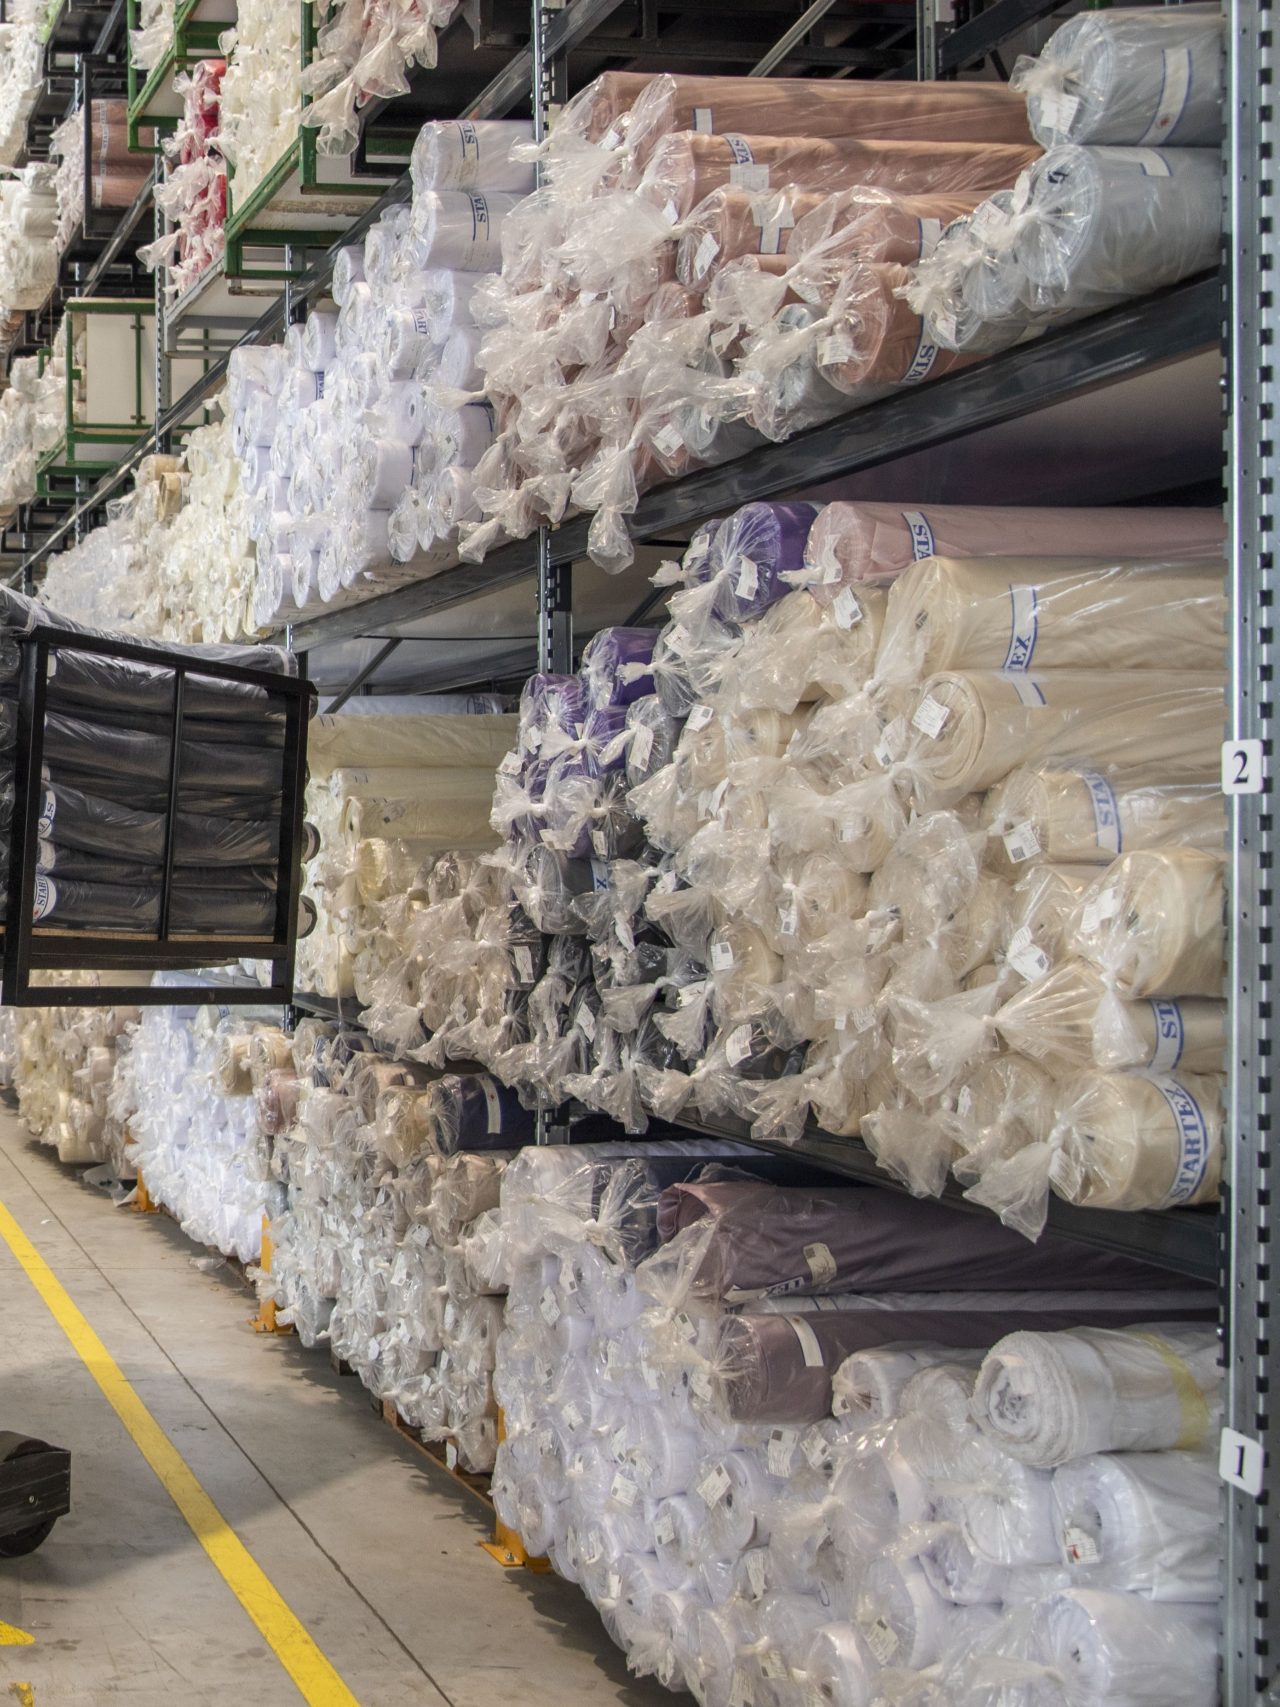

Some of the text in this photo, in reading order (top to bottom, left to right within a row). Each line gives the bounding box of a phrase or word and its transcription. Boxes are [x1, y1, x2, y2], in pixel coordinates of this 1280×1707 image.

[1009, 636, 1031, 670] EX
[1232, 750, 1249, 784] 2
[1164, 1086, 1201, 1199] STARTEX
[1233, 1445, 1245, 1480] 1
